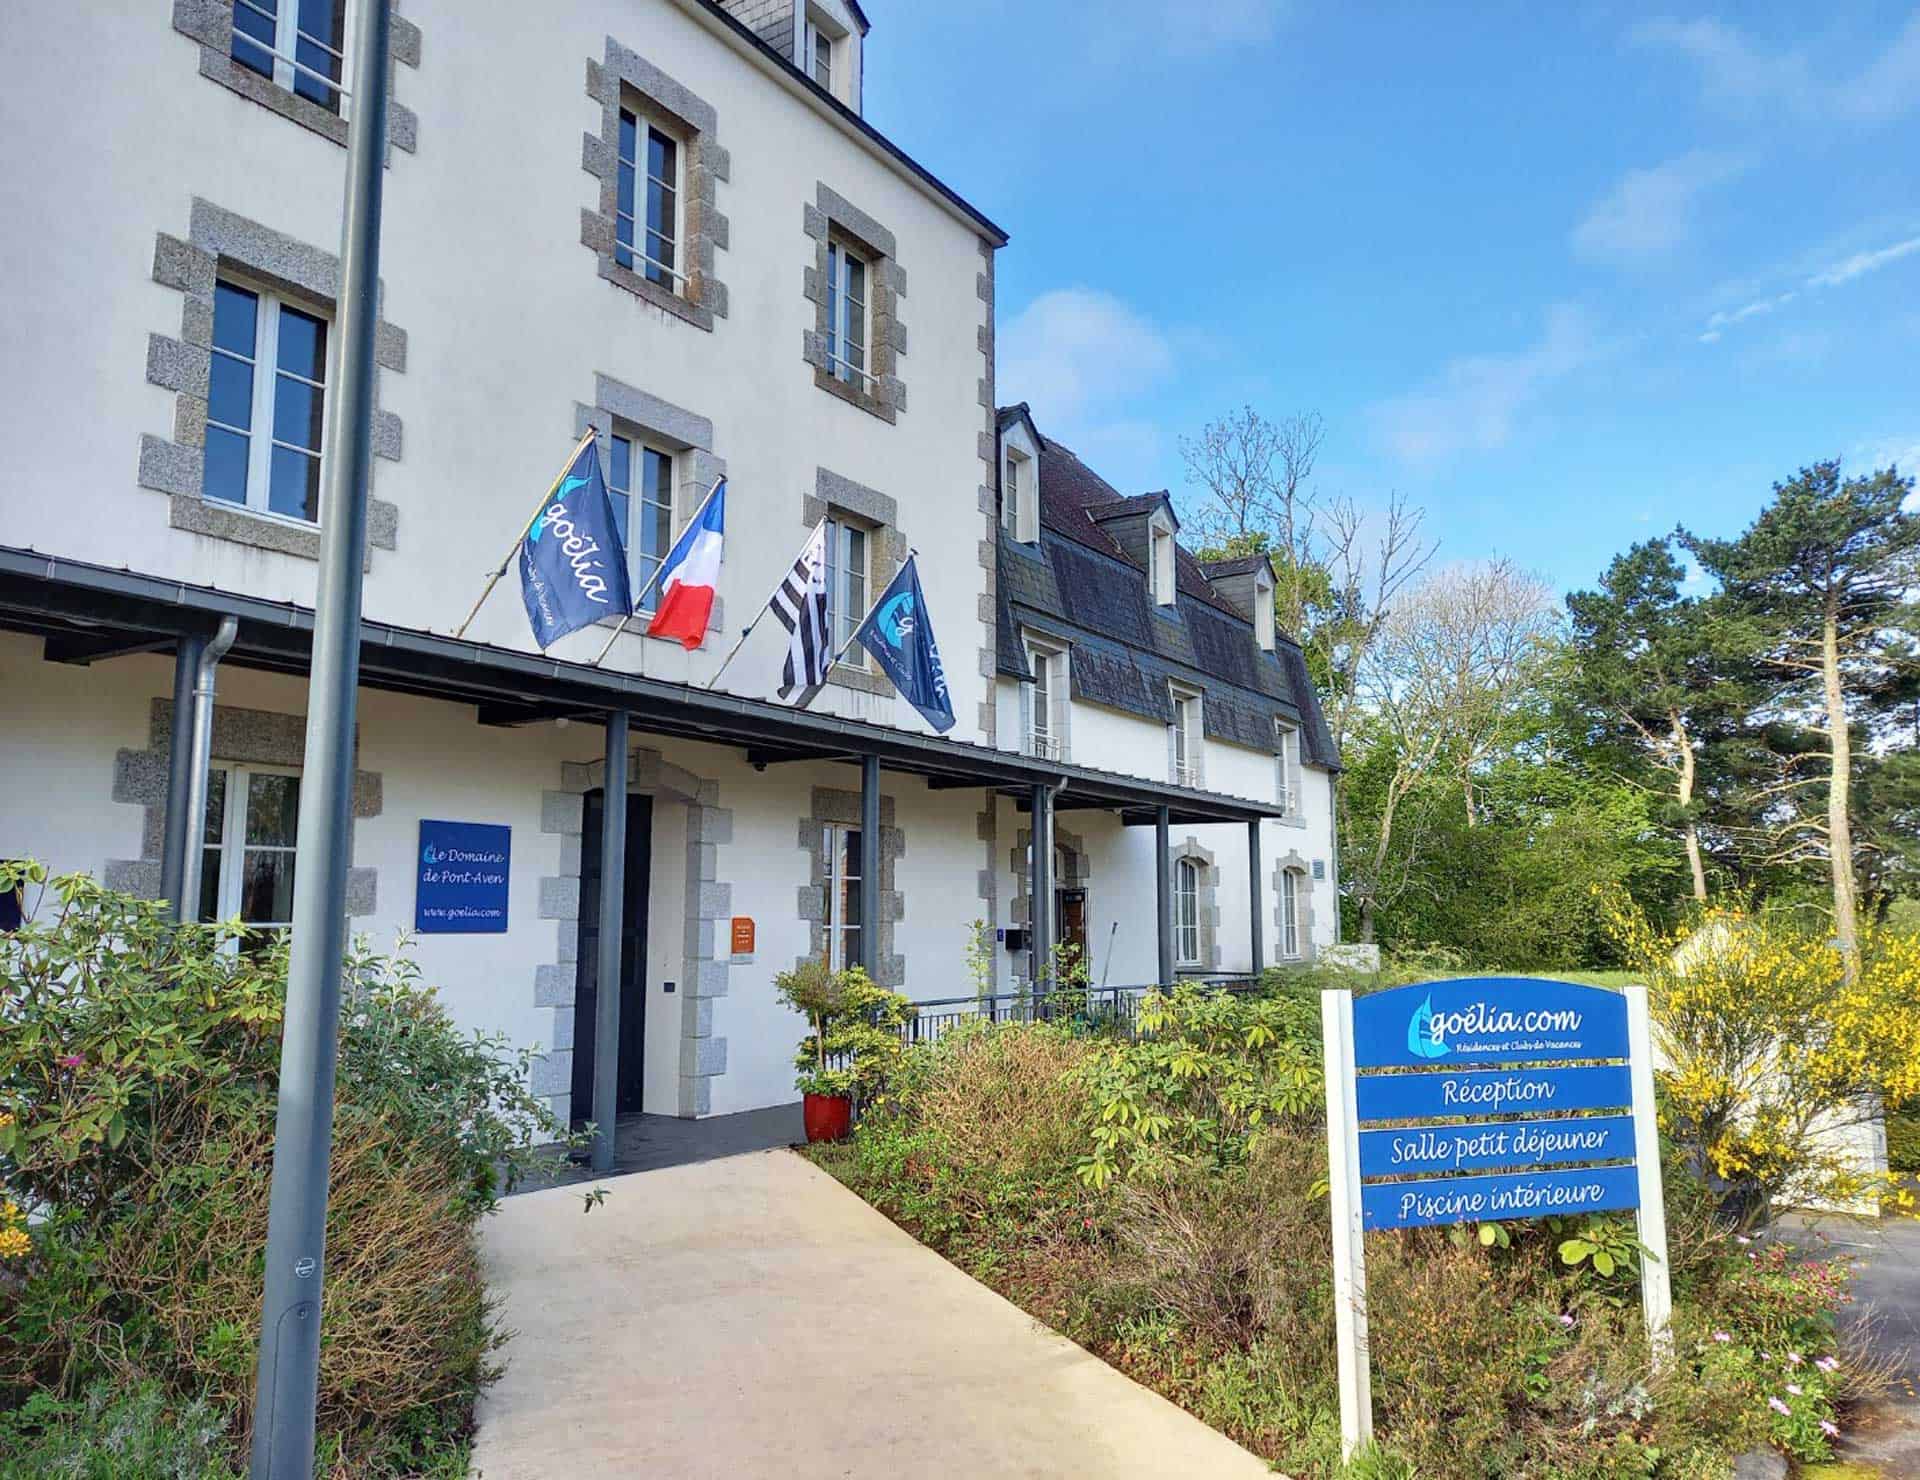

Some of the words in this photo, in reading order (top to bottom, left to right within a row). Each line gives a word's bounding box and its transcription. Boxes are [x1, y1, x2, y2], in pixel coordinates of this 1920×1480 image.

[448, 848, 504, 863] Domaine
[423, 868, 440, 882] de
[441, 870, 504, 884] Pont-Aven
[1430, 1002, 1582, 1045] goélia.com
[1442, 1077, 1556, 1111] Réception
[1391, 1133, 1452, 1164] Salle
[1454, 1132, 1510, 1167] petit
[1512, 1127, 1609, 1161] déjeuner
[1400, 1189, 1489, 1218] Piscine
[1490, 1182, 1605, 1210] intérieure
